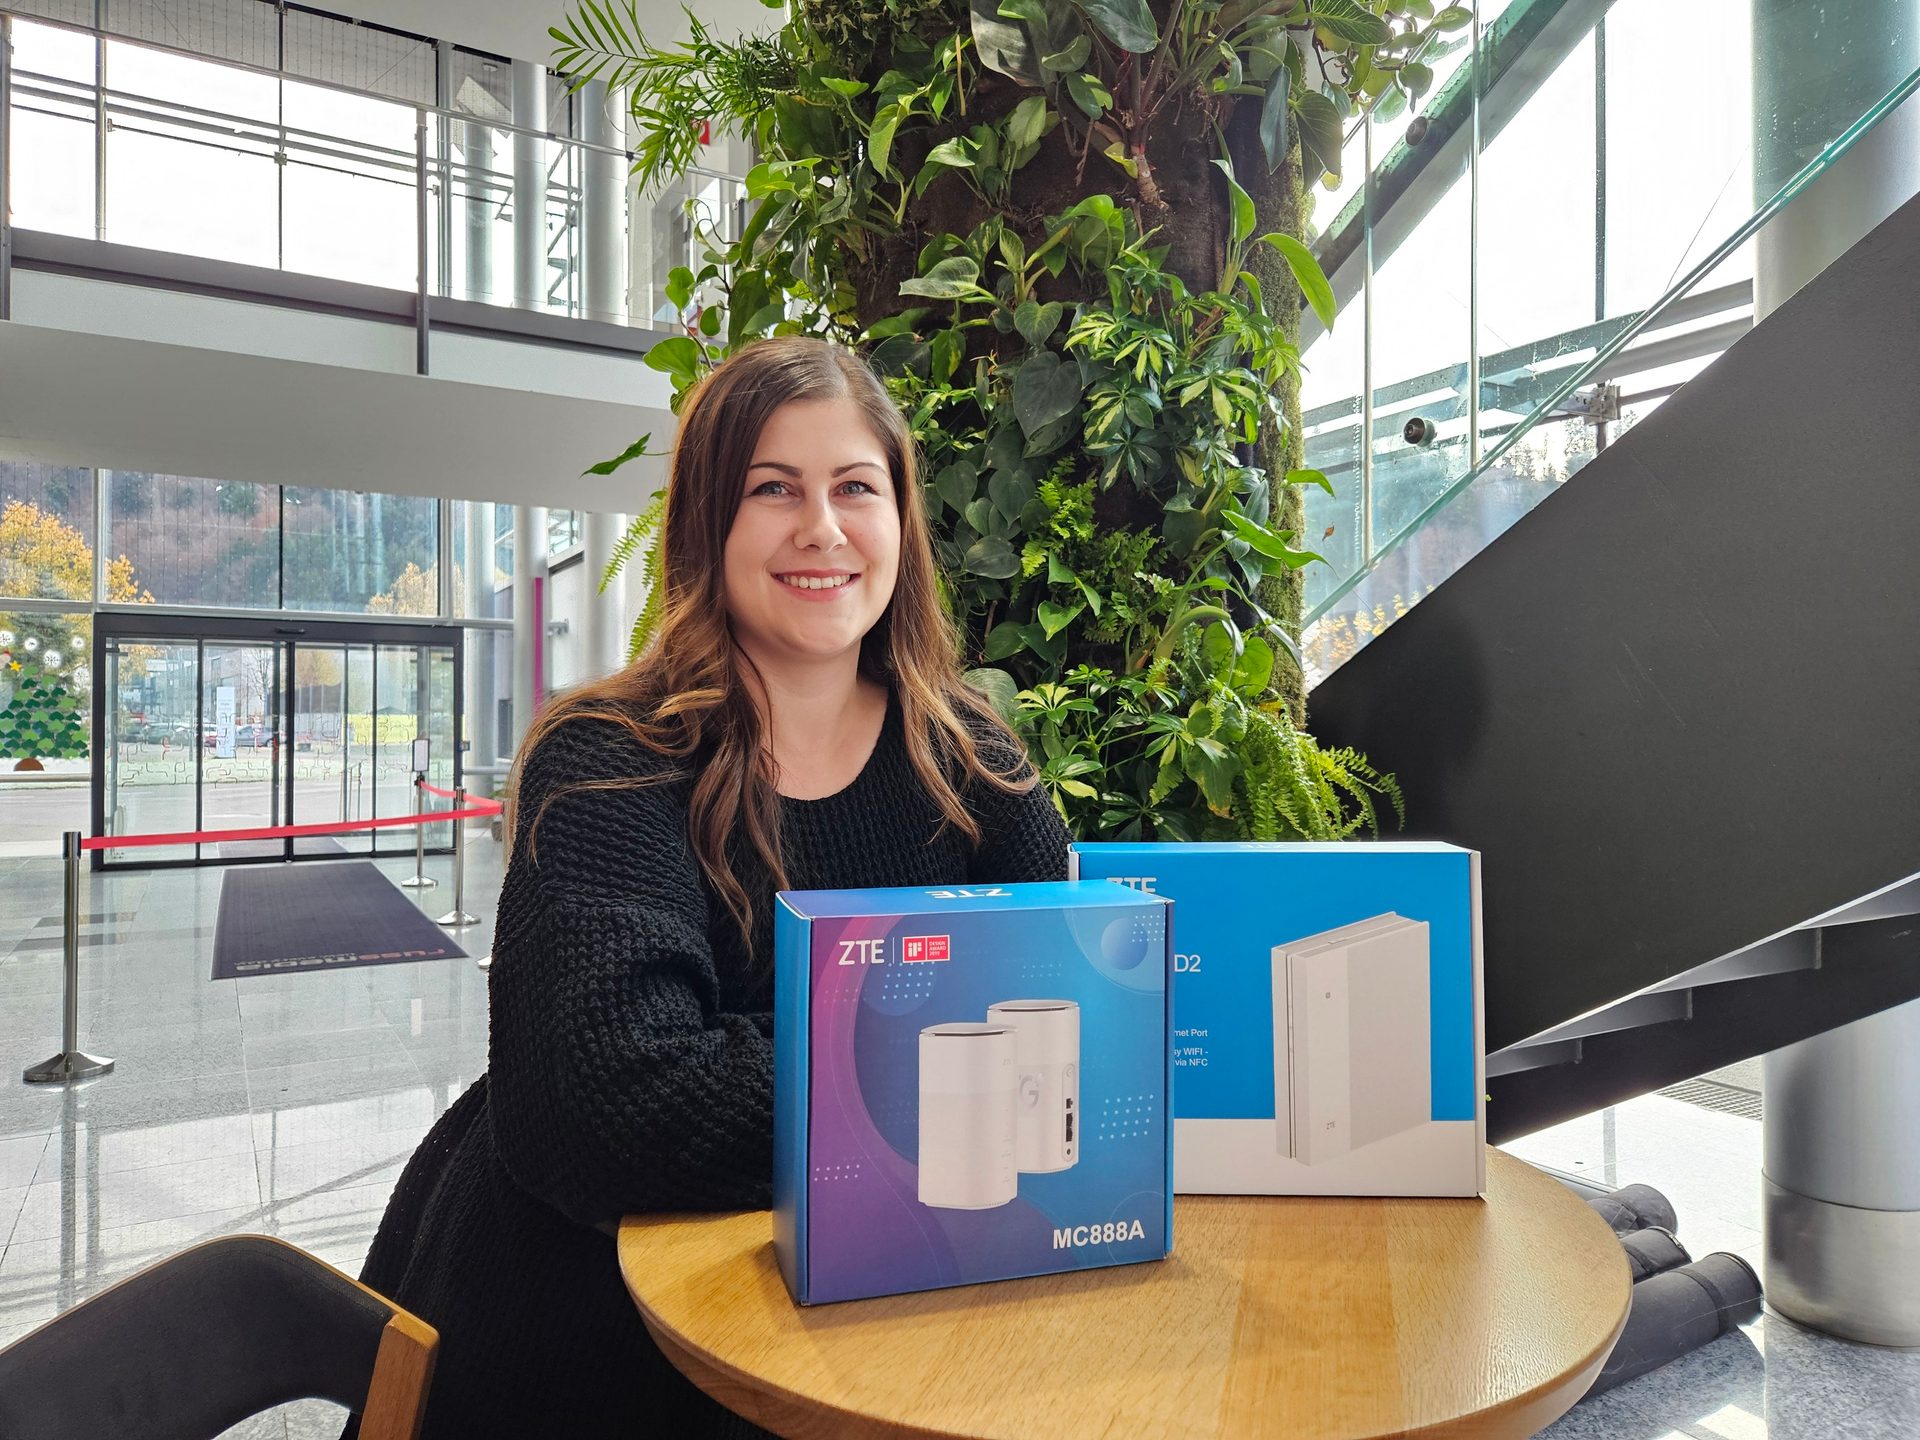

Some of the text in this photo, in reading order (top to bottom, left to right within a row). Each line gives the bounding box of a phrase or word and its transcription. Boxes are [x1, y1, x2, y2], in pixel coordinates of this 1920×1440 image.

[925, 888, 1013, 899] ZTE
[838, 939, 885, 966] ZTE
[1190, 1028, 1208, 1037] Port
[1175, 1058, 1209, 1067] via NFC
[1053, 1219, 1146, 1250] MC888A
